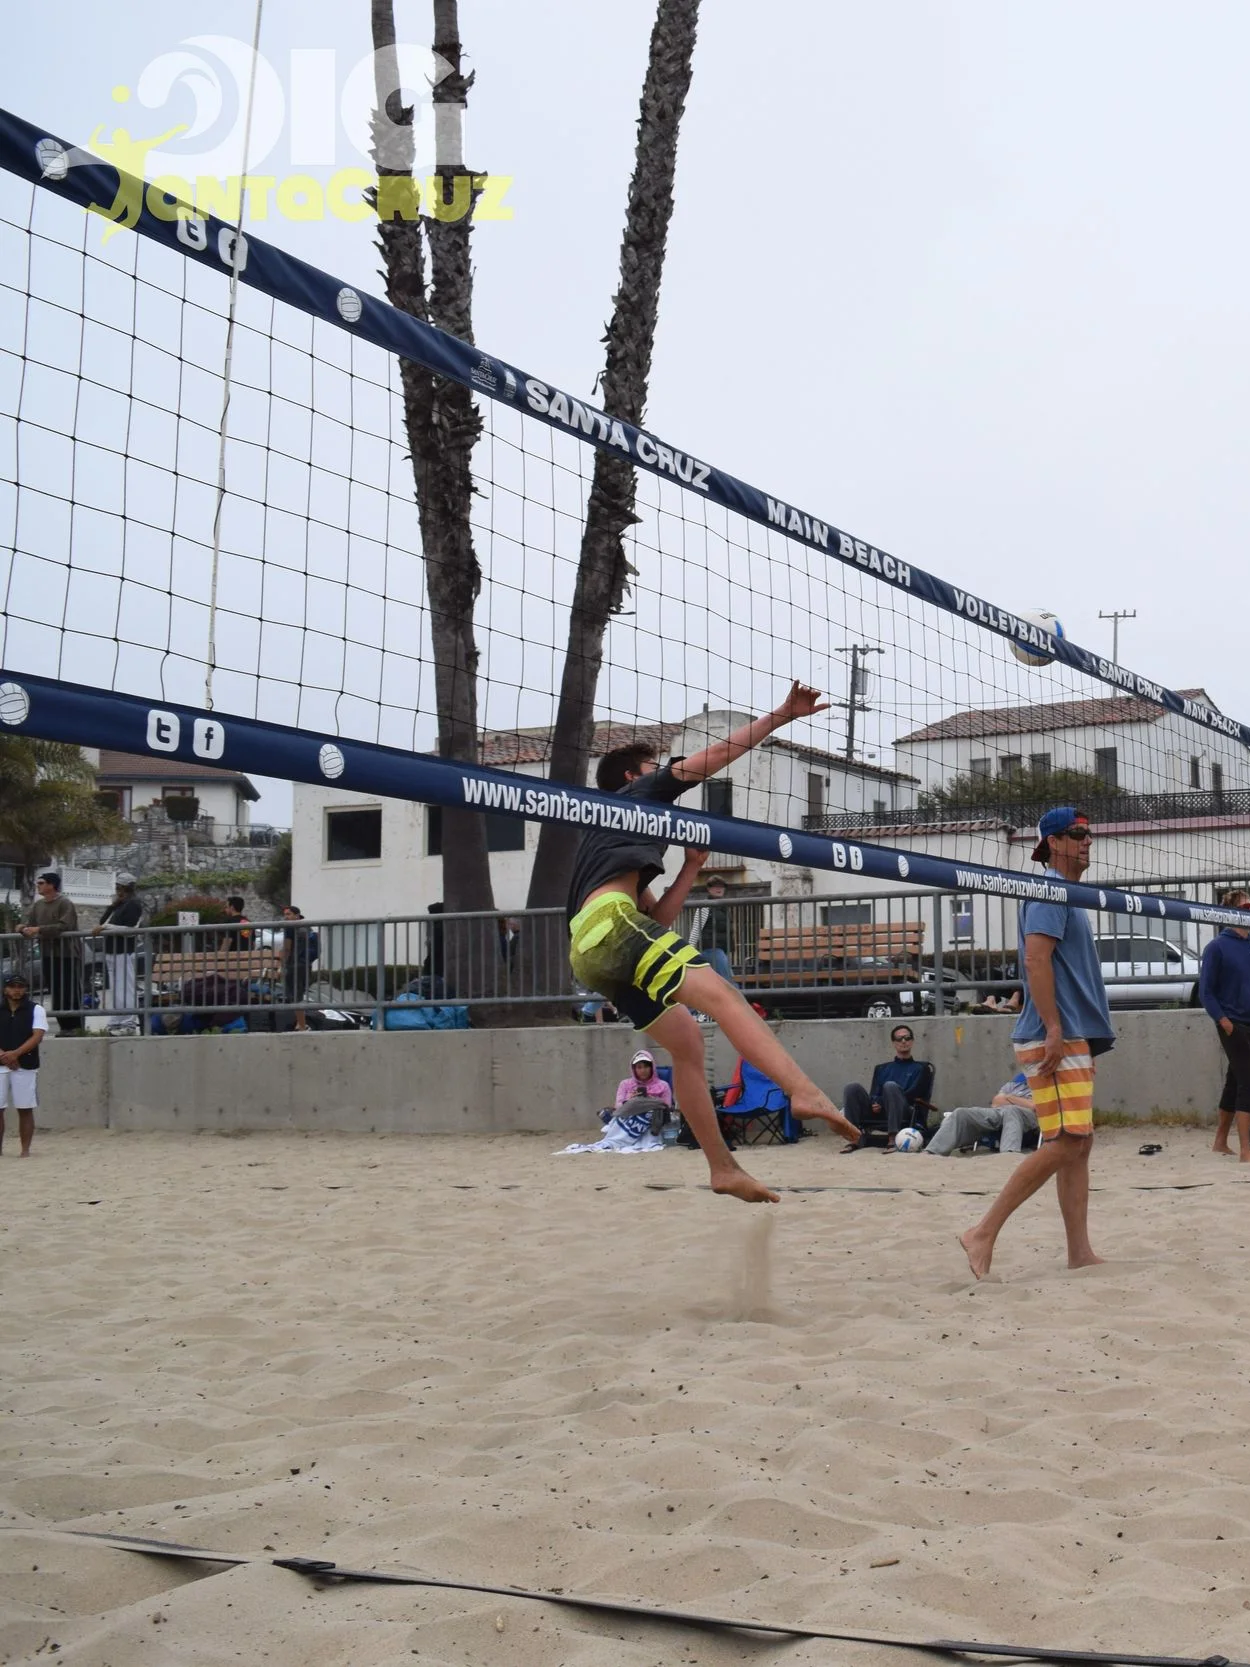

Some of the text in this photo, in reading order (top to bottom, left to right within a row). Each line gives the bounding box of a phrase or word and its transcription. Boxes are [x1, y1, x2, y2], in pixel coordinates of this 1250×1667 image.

[525, 379, 711, 491] SANTA CRUZ
[767, 497, 911, 587] MAIN BEACH
[953, 588, 1056, 654] VOLLEYBALL
[1098, 658, 1134, 690] SANTA
[1136, 677, 1164, 703] CRUZ
[1183, 699, 1208, 723] MAIN
[462, 777, 711, 845] www.santacruzwharf.com
[956, 870, 1068, 903] www.santacruzwharf.com
